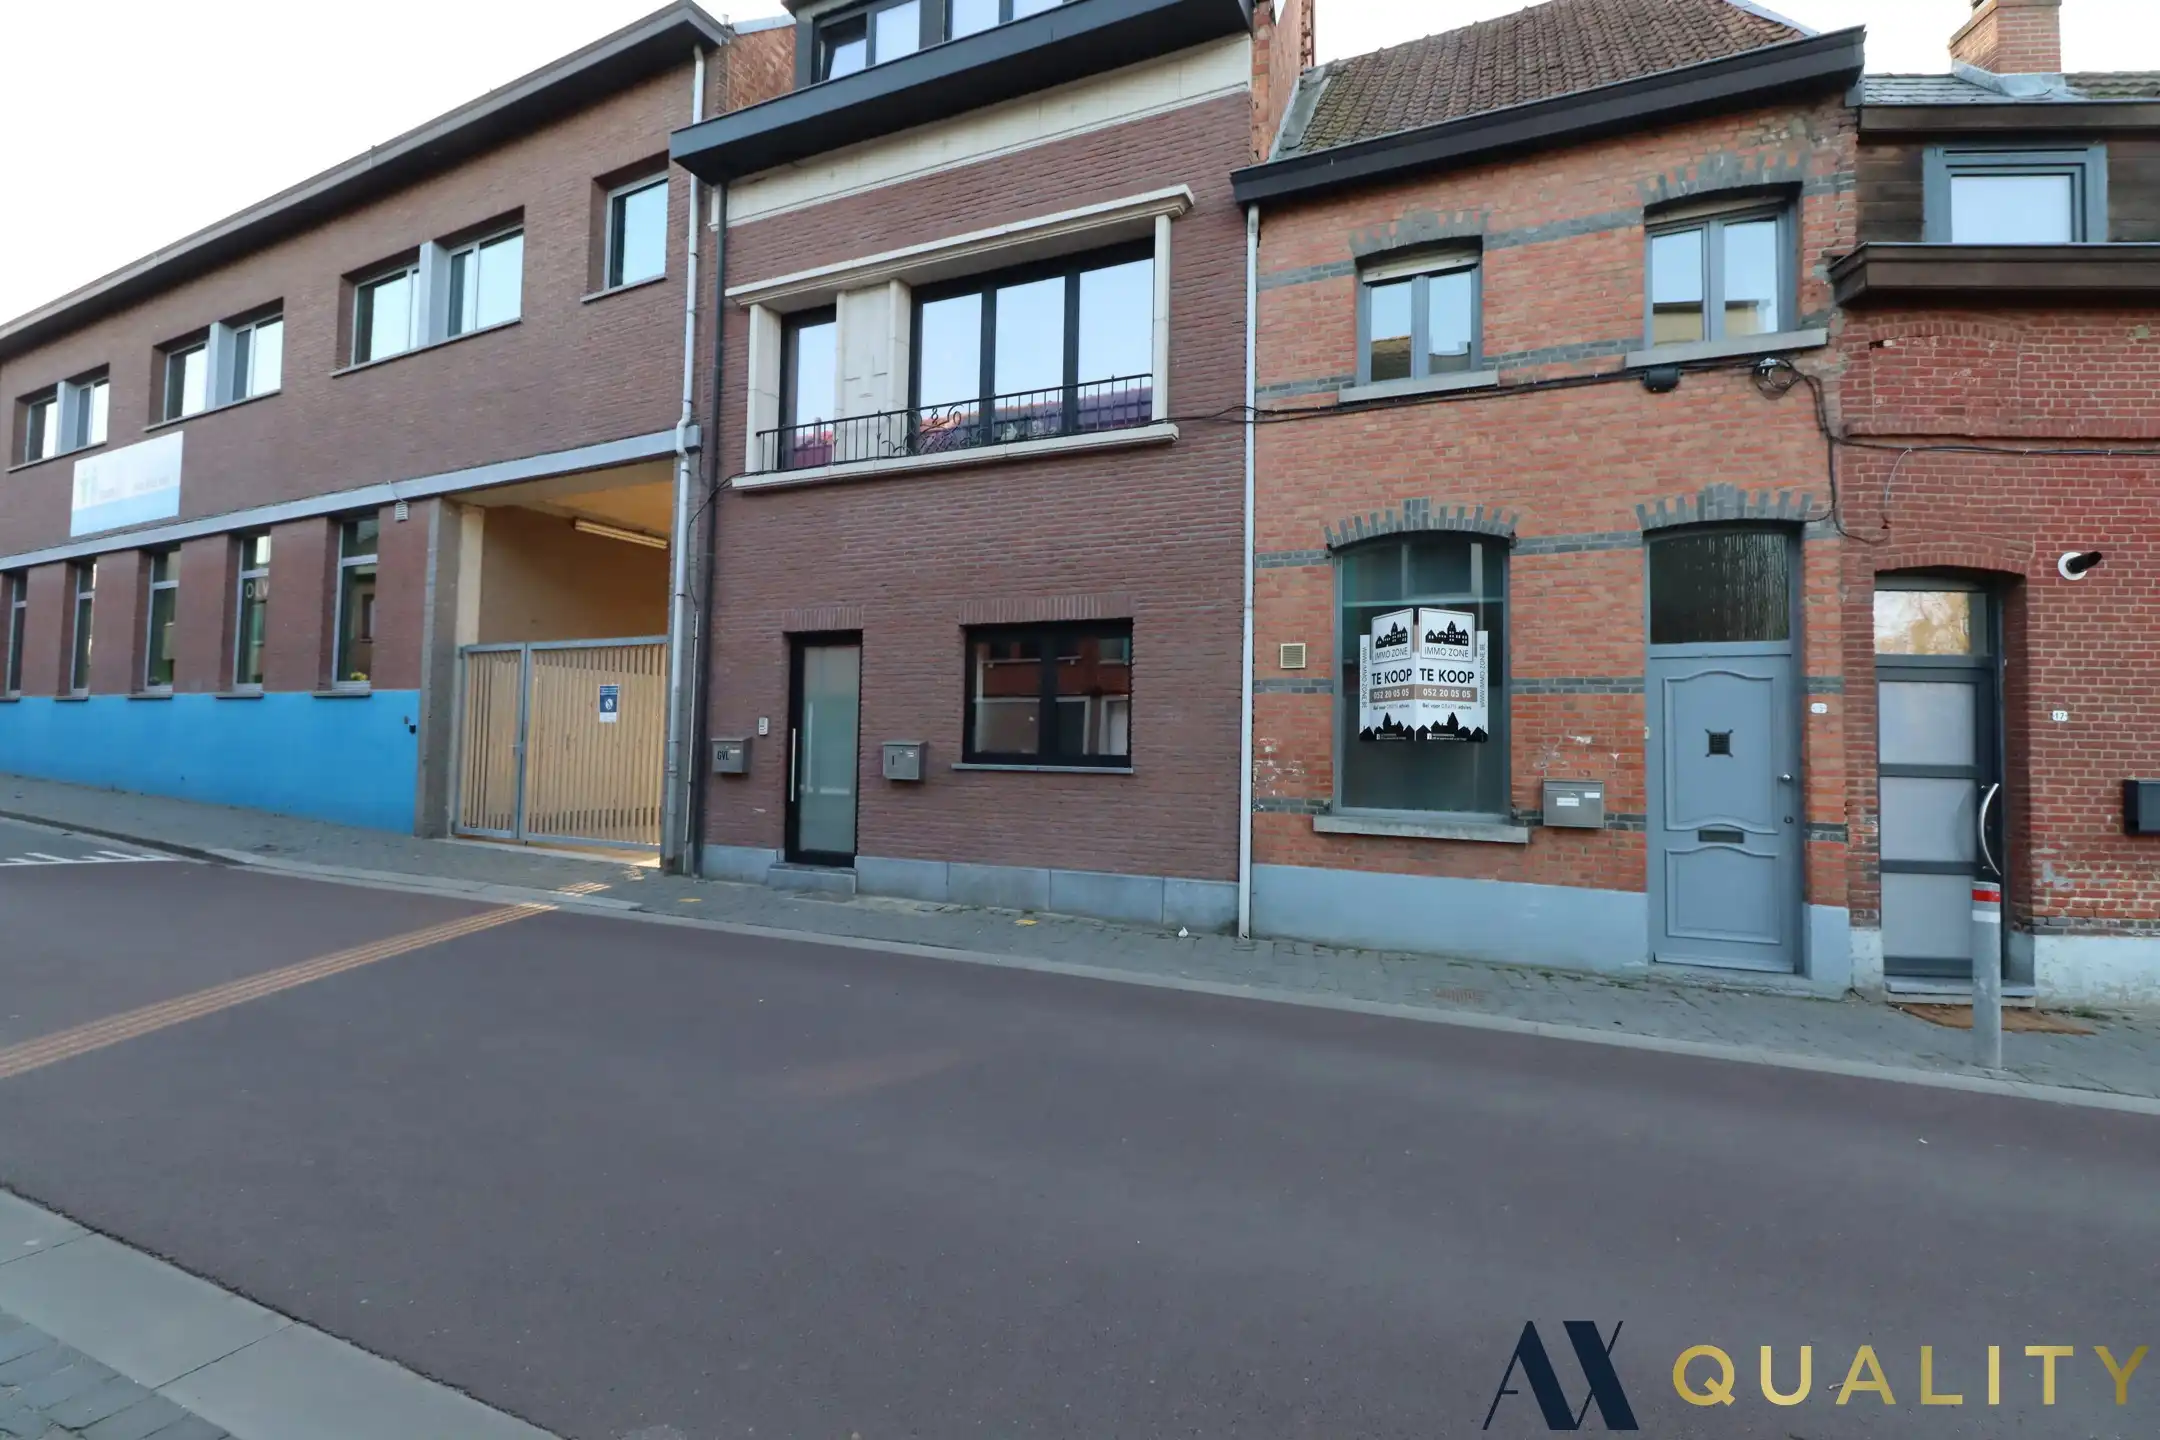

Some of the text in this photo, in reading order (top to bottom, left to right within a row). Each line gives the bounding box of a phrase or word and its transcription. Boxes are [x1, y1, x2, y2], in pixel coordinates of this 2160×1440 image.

[1375, 646, 1408, 660] IMMO ZONE
[1424, 646, 1469, 658] IMMO ZONE
[1371, 668, 1412, 685] TE KOOP
[1419, 668, 1475, 684] TE KOOP
[1373, 688, 1410, 700] 052 20 05 05
[1422, 688, 1471, 699] 052 20 05 05
